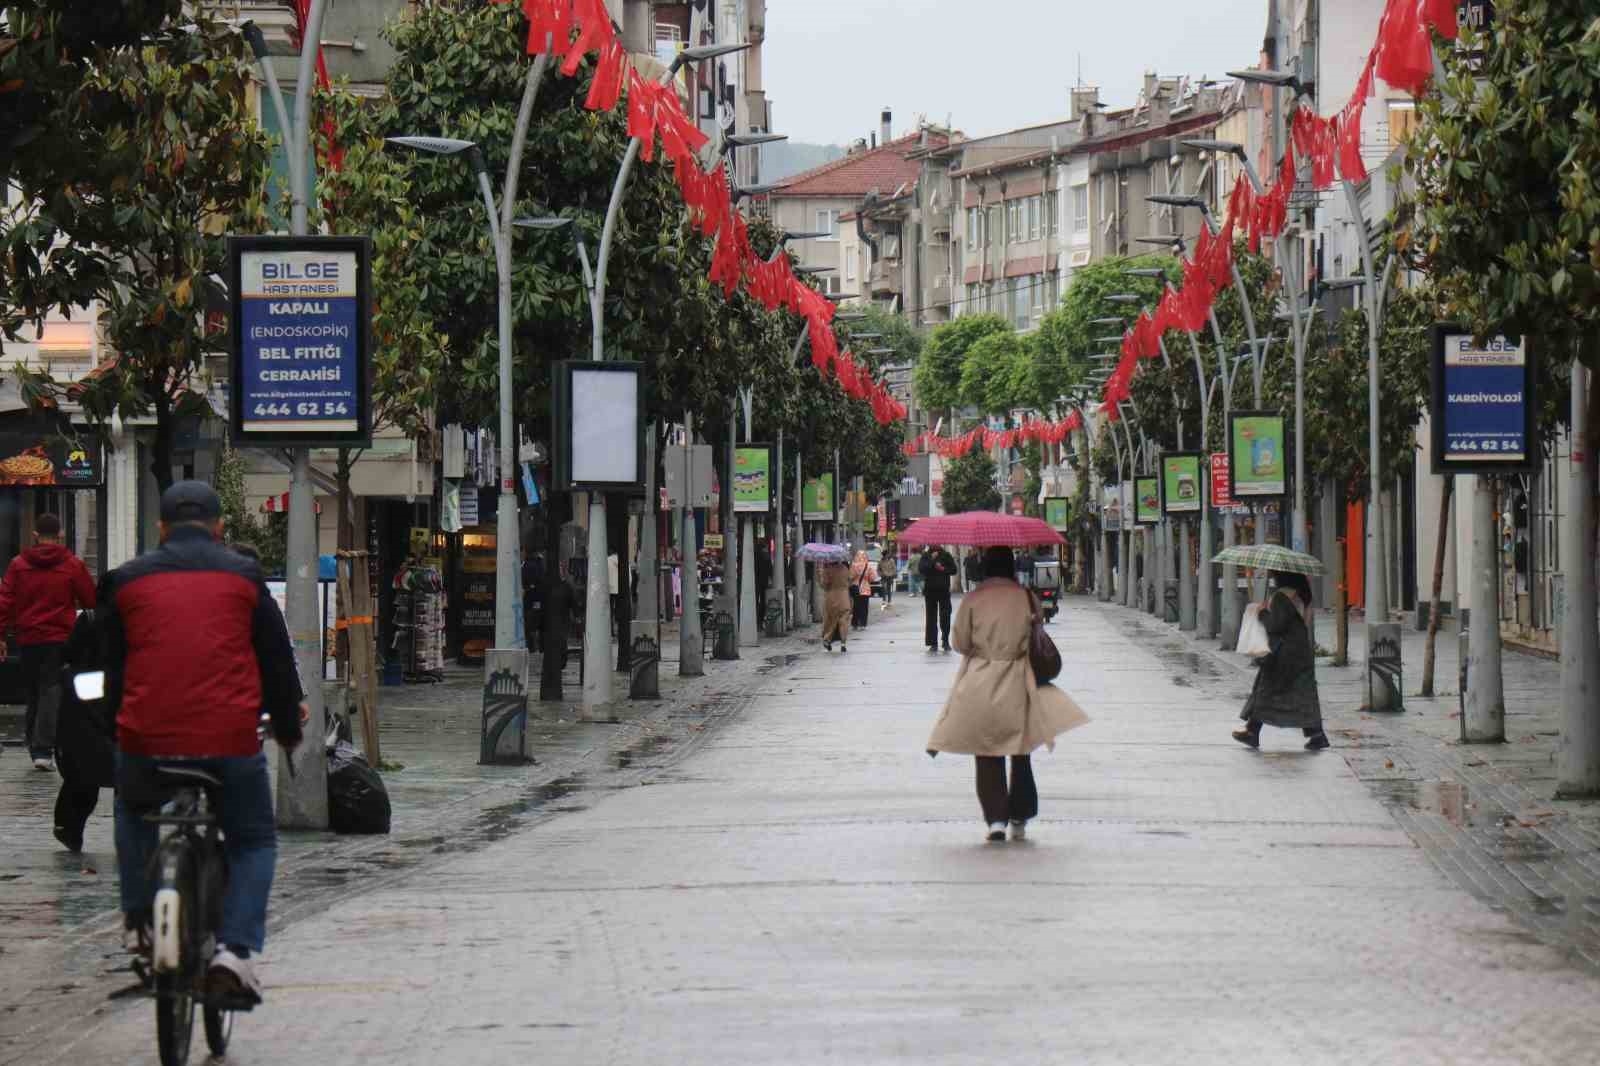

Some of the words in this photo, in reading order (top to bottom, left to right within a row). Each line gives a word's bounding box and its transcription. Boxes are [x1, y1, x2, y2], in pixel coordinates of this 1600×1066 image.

[269, 302, 329, 315] KAPALI
[250, 324, 349, 339] (ENDOSKOPİK)
[259, 347, 291, 360] BEL
[294, 344, 341, 359] FITIĞI
[259, 366, 341, 381] CERRAHİSİ
[1448, 391, 1522, 403] KARDİYOLOJİ
[254, 403, 291, 416] 444
[296, 402, 319, 415] 62
[324, 402, 348, 415] 54
[1450, 440, 1478, 450] 444
[1481, 440, 1498, 450] 62
[1501, 440, 1519, 450] 54
